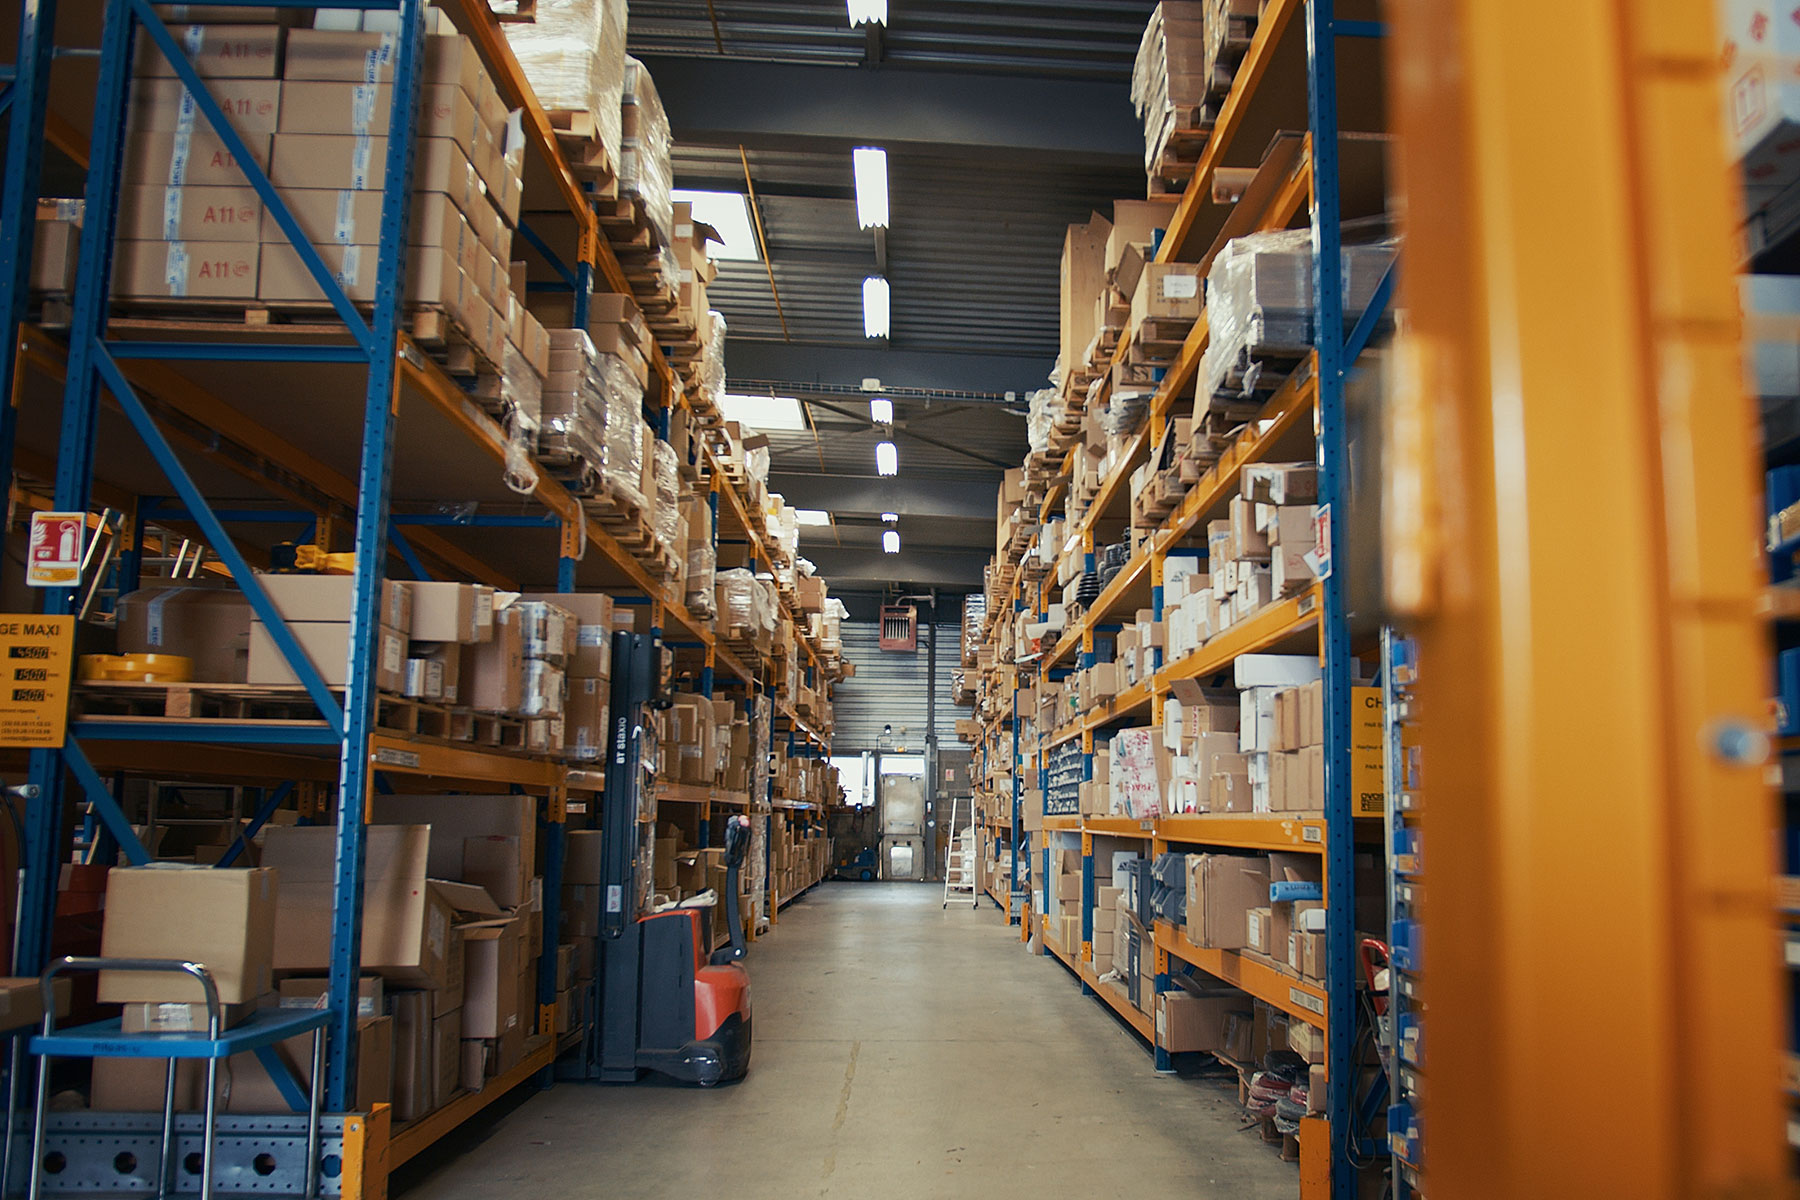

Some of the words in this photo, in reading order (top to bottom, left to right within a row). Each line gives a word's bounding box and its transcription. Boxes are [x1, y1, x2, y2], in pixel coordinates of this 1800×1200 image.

[219, 41, 249, 58] A11
[223, 98, 252, 115] A11
[203, 206, 235, 223] A11
[198, 260, 230, 279] A11
[23, 623, 60, 636] MAXI
[616, 752, 626, 764] BT
